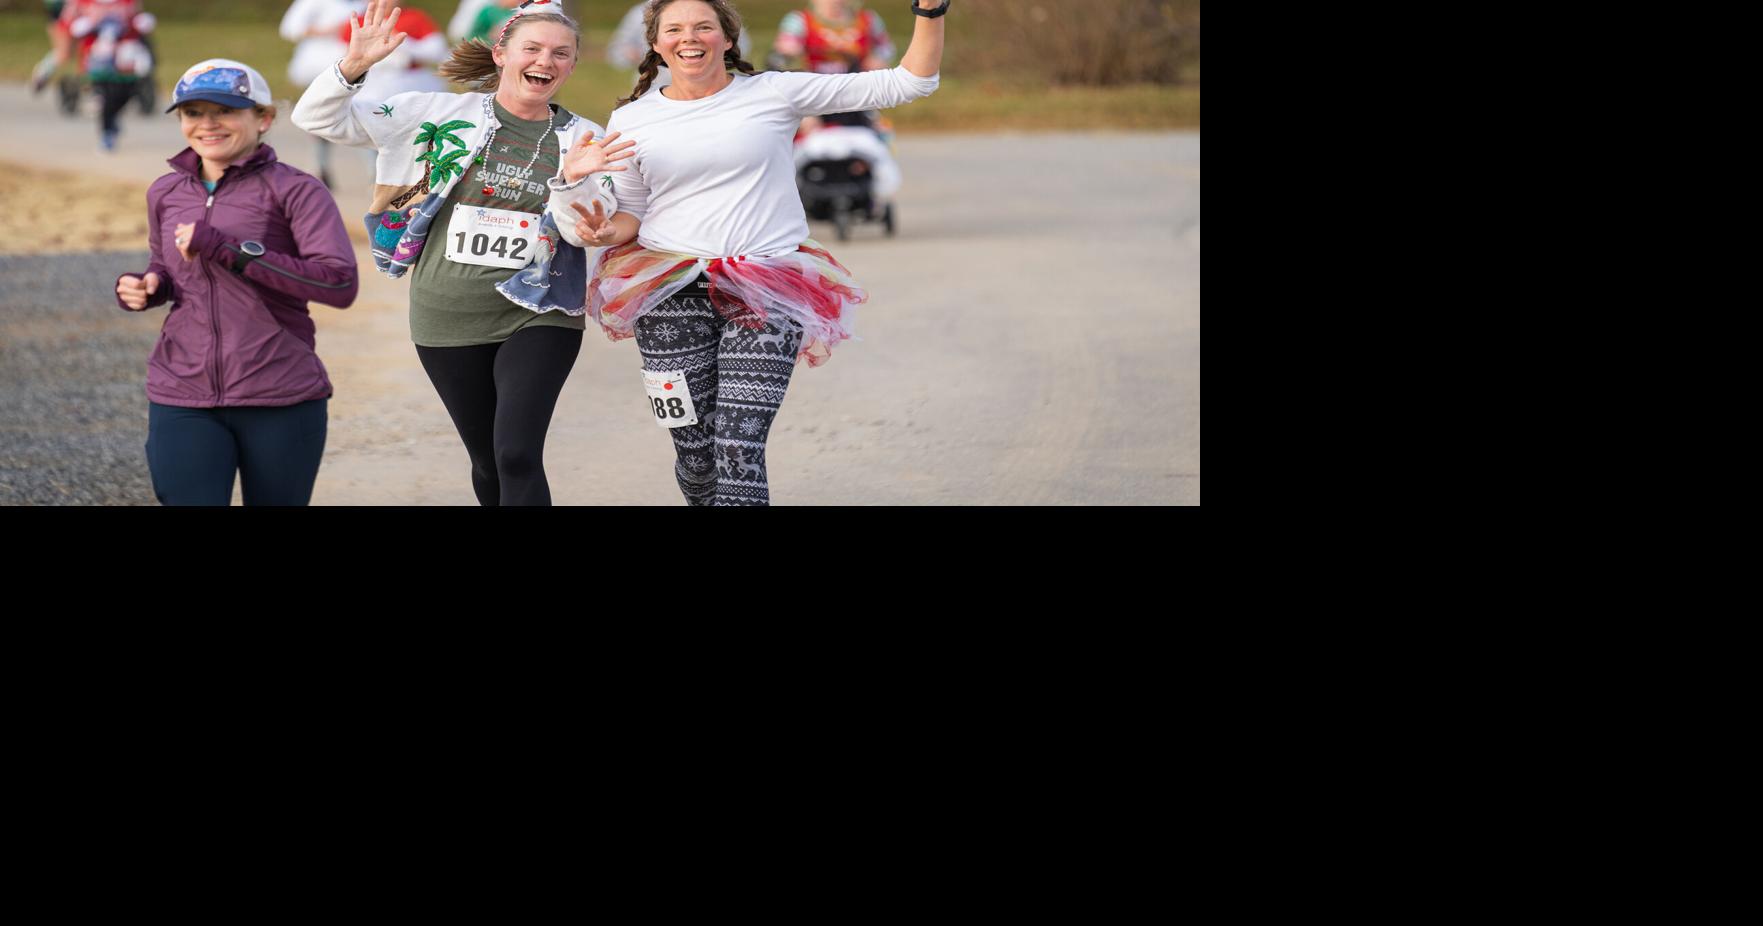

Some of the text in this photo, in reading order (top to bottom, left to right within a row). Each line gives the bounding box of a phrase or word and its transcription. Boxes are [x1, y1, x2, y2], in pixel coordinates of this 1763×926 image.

[496, 163, 533, 179] UGLY
[456, 231, 528, 260] 1042
[648, 395, 685, 419] 88
